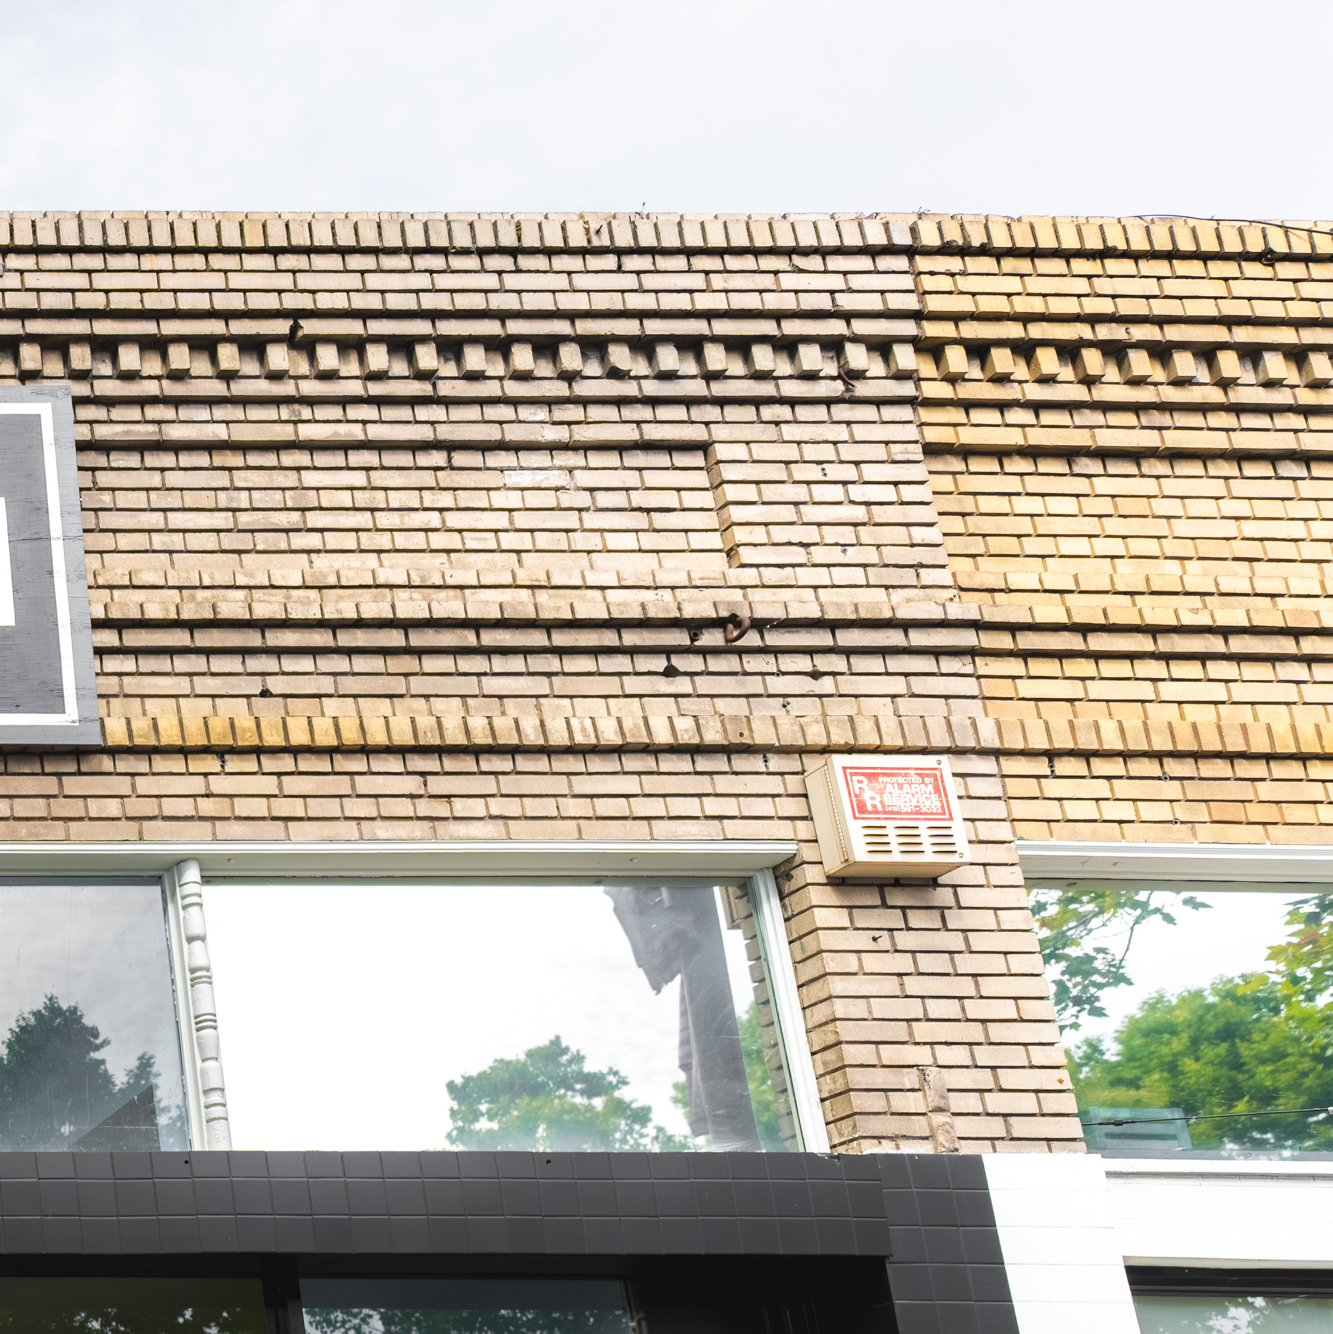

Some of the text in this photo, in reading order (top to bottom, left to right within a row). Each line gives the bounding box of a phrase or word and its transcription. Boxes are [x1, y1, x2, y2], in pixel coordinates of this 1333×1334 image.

[878, 776, 934, 784] PROTECTED BY
[885, 784, 934, 794] ALARM
[883, 793, 940, 804] SERVICE
